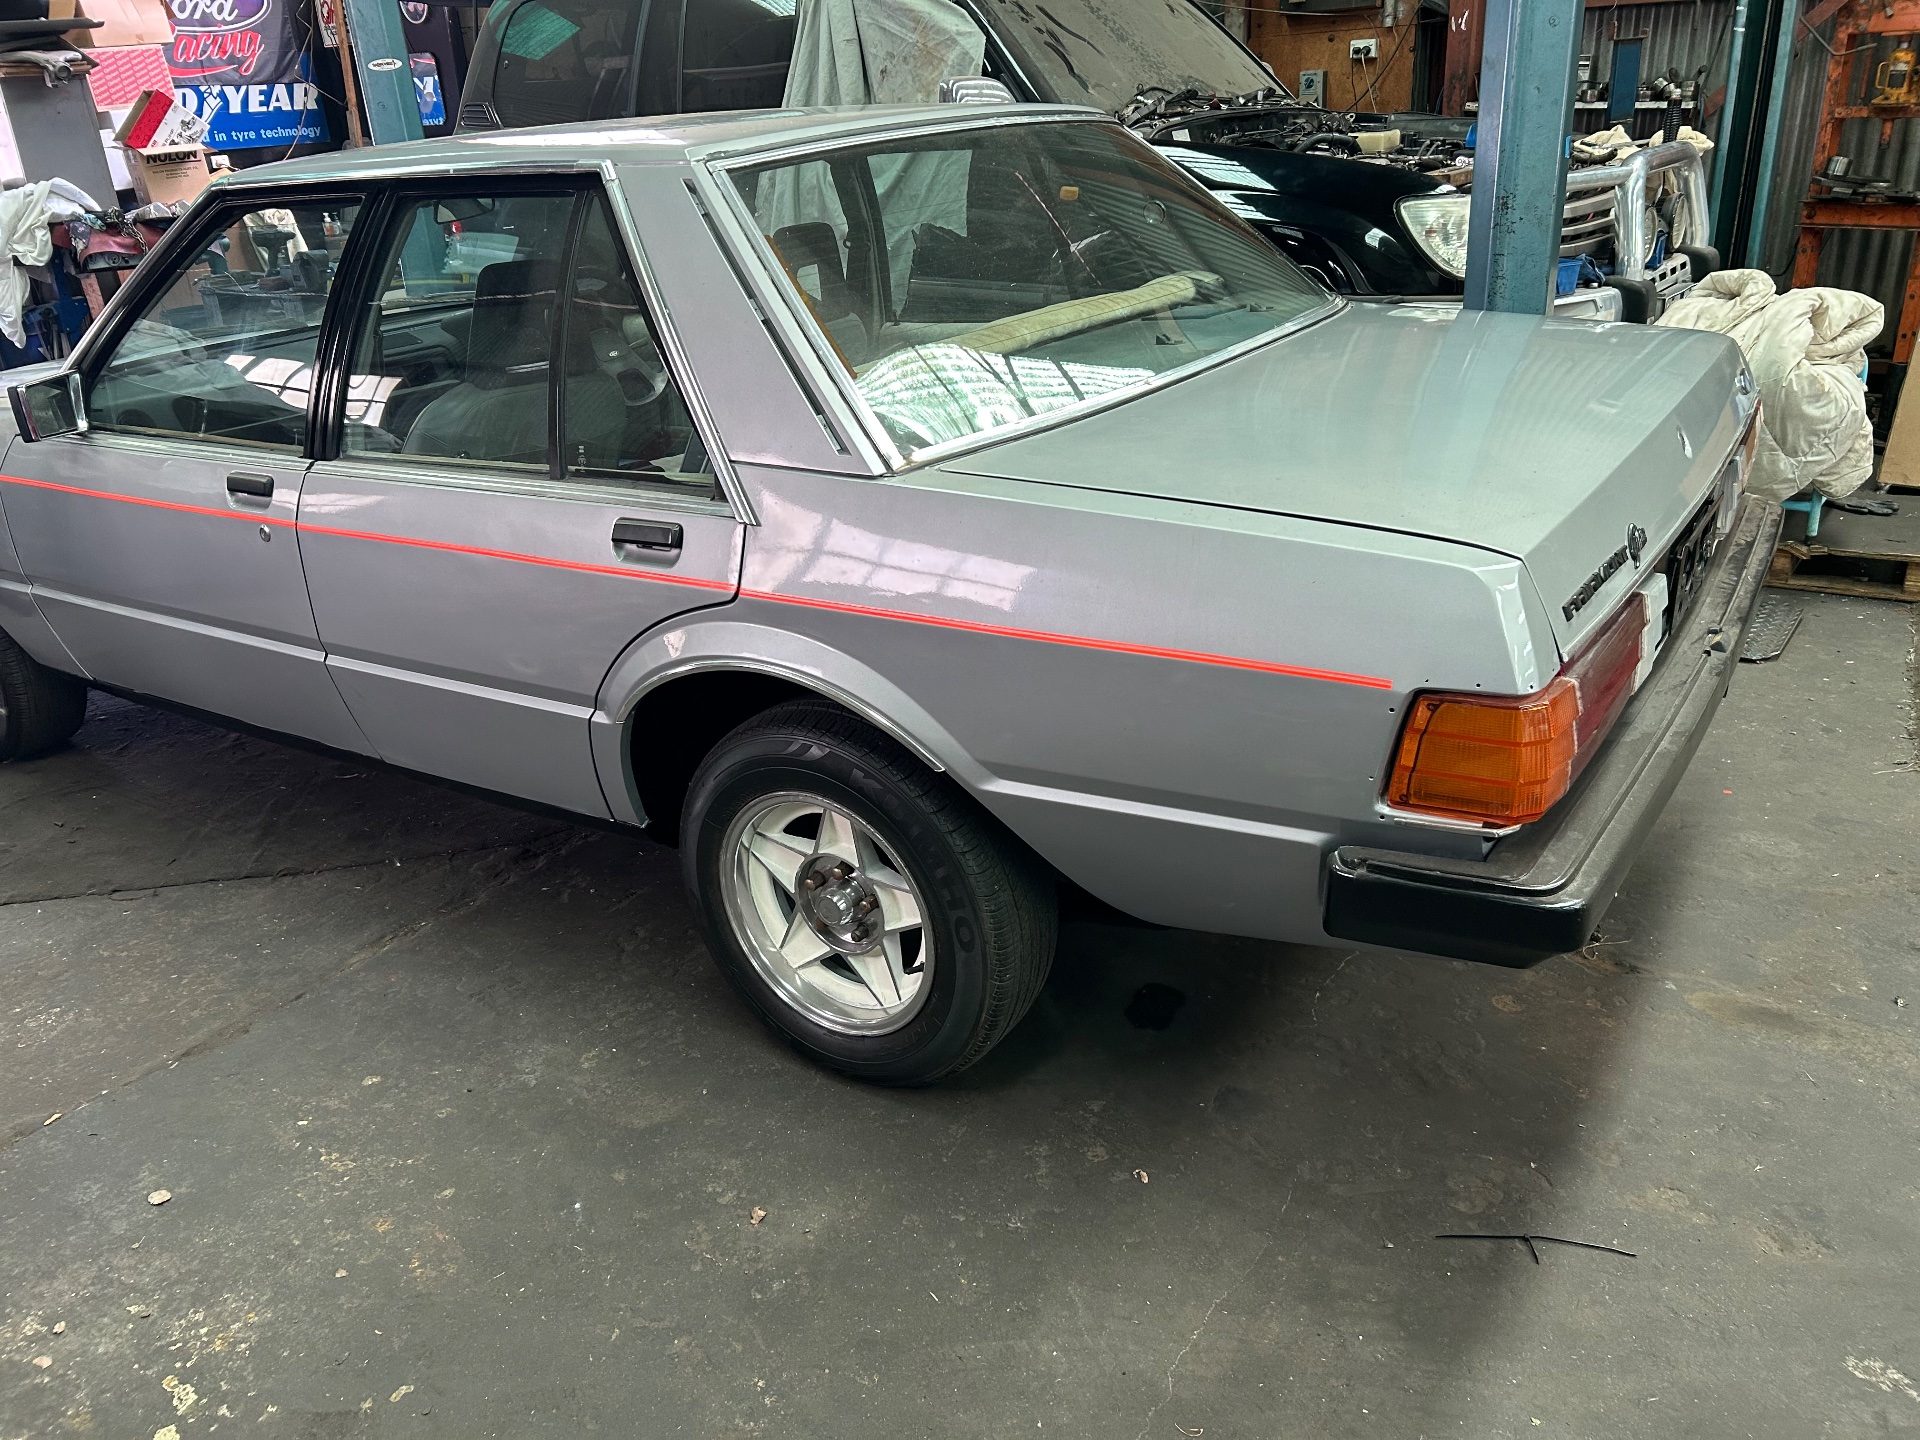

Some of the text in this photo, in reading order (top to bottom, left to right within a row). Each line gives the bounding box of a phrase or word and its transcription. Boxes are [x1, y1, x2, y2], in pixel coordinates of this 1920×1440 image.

[172, 0, 238, 21] ord
[173, 30, 265, 75] acing
[213, 130, 227, 142] in
[231, 130, 256, 142] tyre
[260, 125, 321, 139] technology
